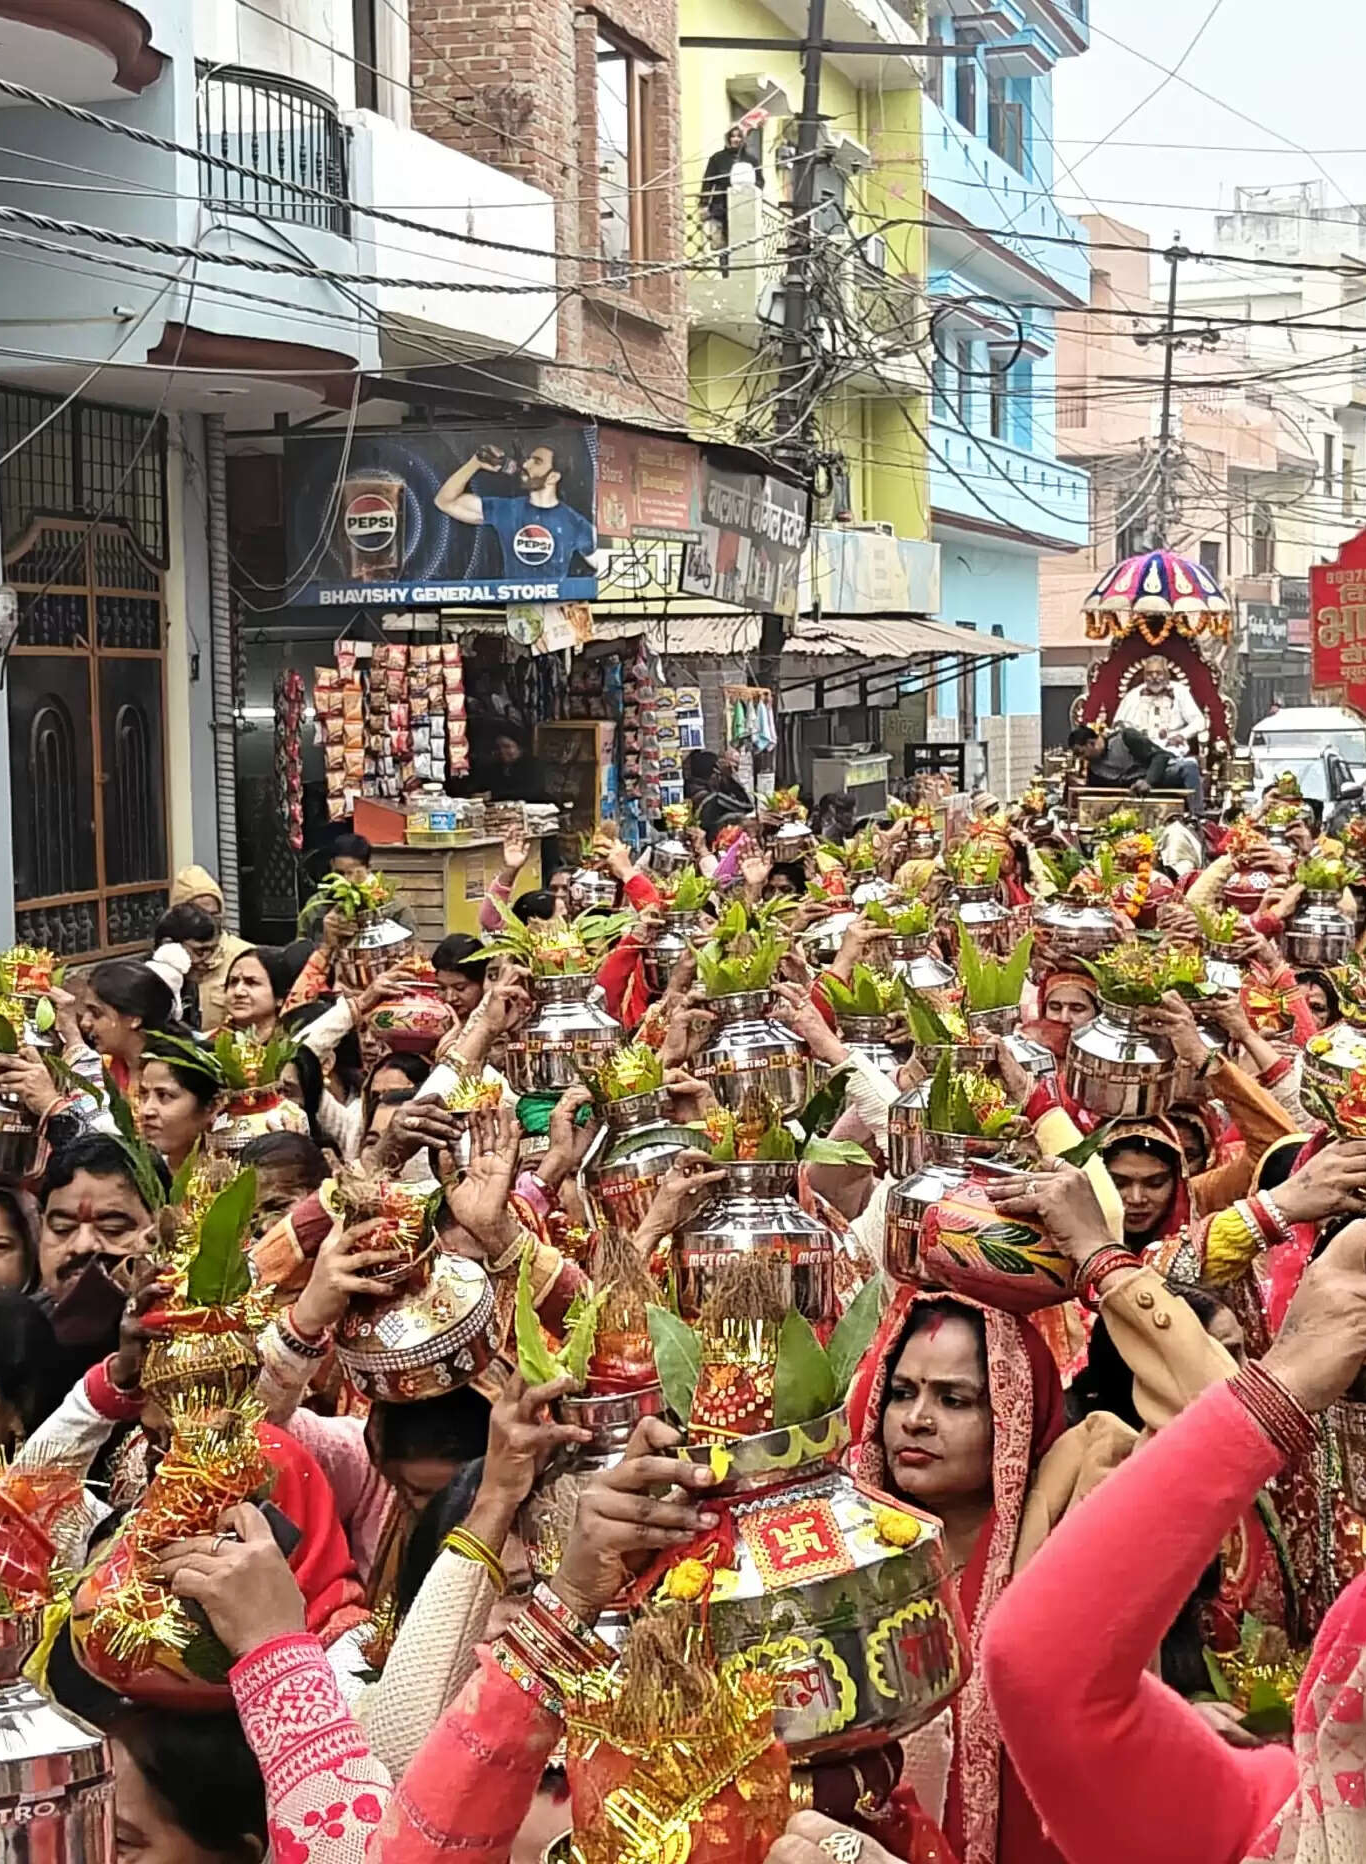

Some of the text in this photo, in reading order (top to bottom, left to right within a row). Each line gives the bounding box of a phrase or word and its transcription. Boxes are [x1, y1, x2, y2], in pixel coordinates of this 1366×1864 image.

[347, 516, 395, 530] PEPSI
[516, 538, 552, 551] PEPSI
[319, 584, 559, 605] BHAVISHY GENERAL STORE
